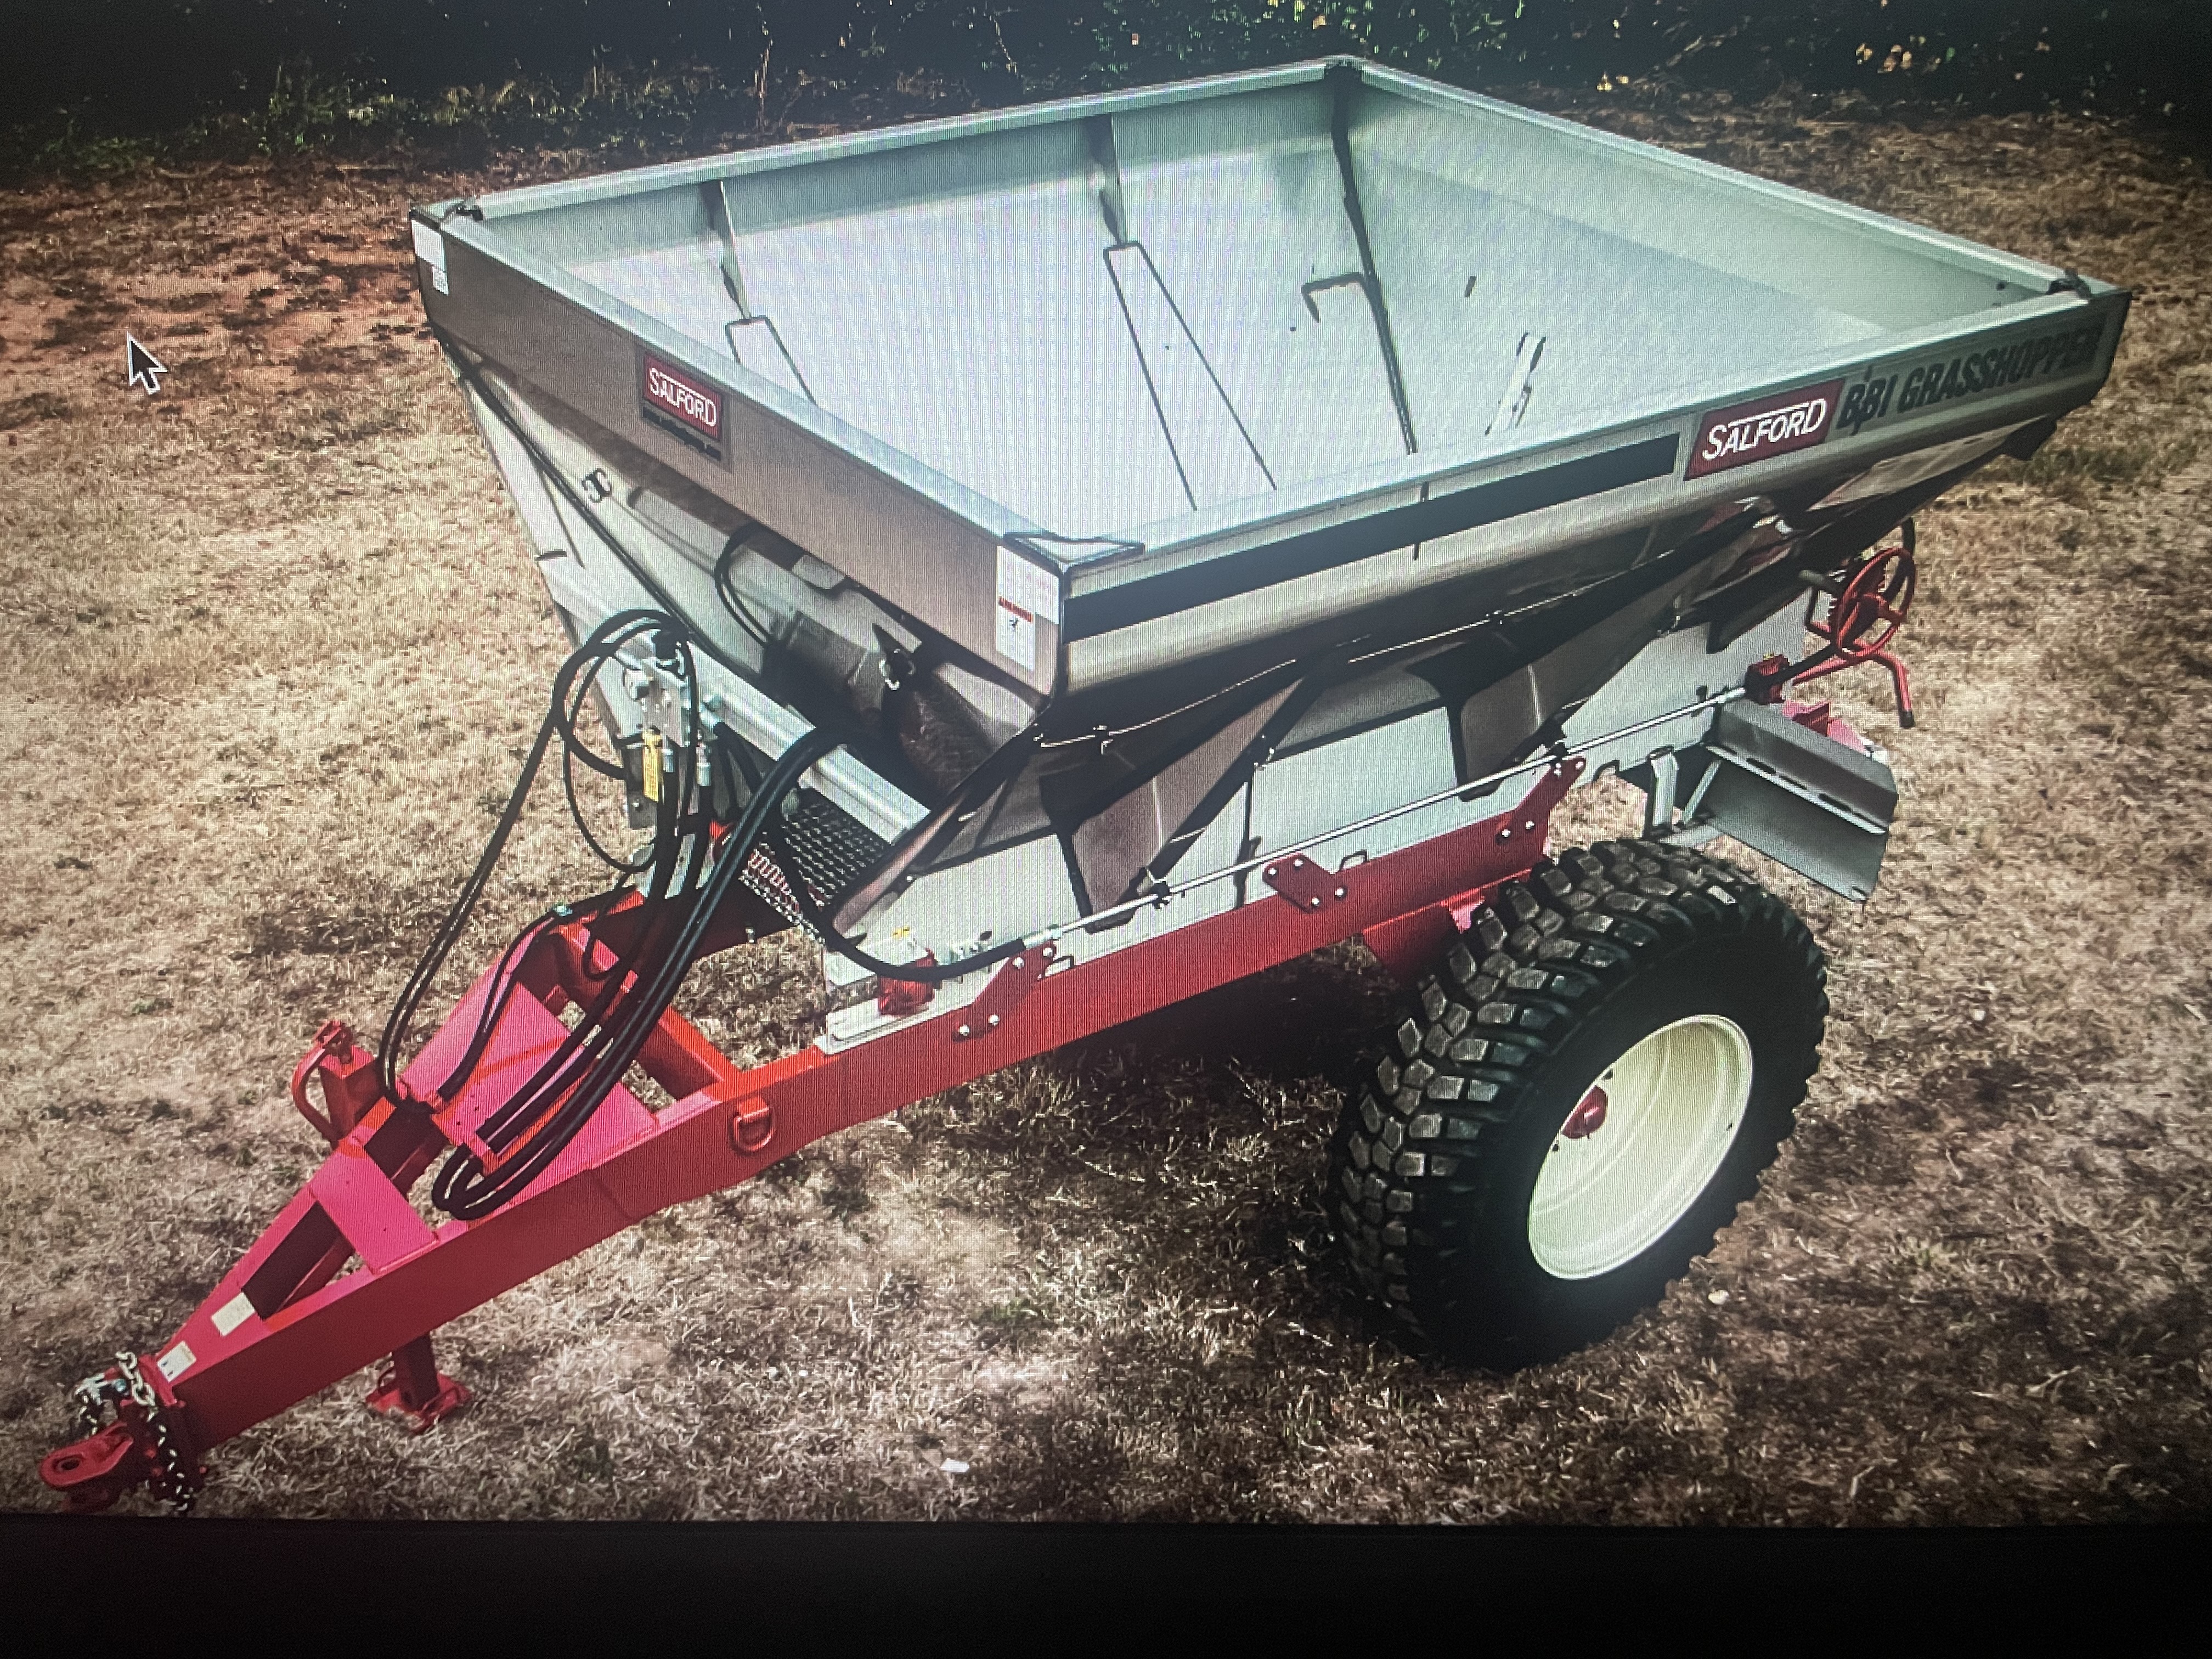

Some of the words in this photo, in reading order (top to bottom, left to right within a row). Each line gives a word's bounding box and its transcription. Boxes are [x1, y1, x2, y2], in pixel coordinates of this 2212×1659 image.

[650, 367, 716, 427] SALFORD
[1836, 365, 1898, 435] BBI
[1702, 398, 1826, 460] SALFORD
